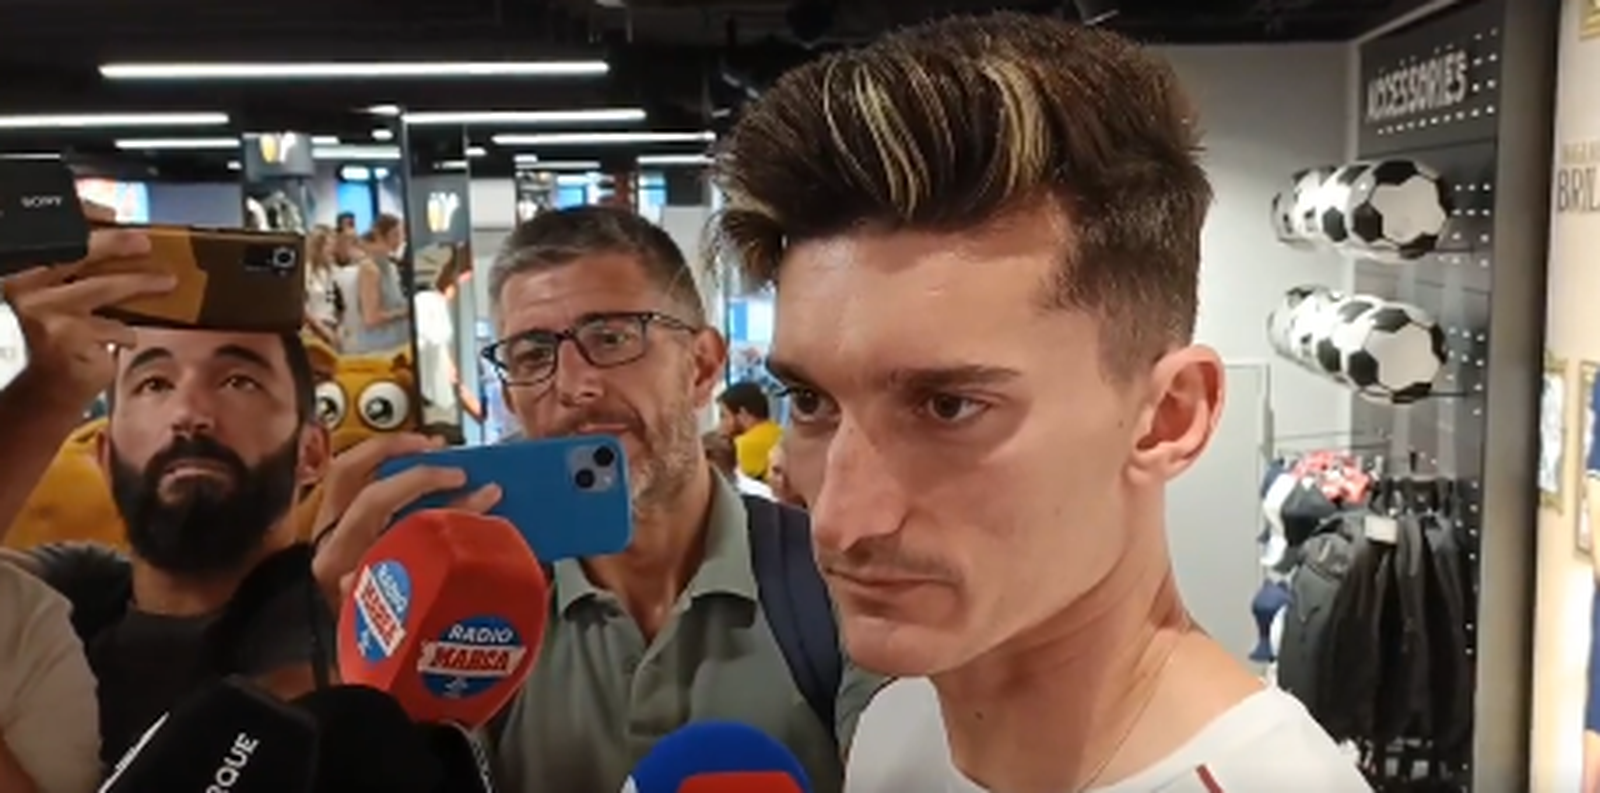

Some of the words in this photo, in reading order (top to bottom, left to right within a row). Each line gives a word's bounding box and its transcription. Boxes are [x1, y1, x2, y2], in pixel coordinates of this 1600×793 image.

[1366, 50, 1467, 121] ACCESSORIES
[21, 195, 62, 208] SONY
[448, 623, 514, 643] RADIO
